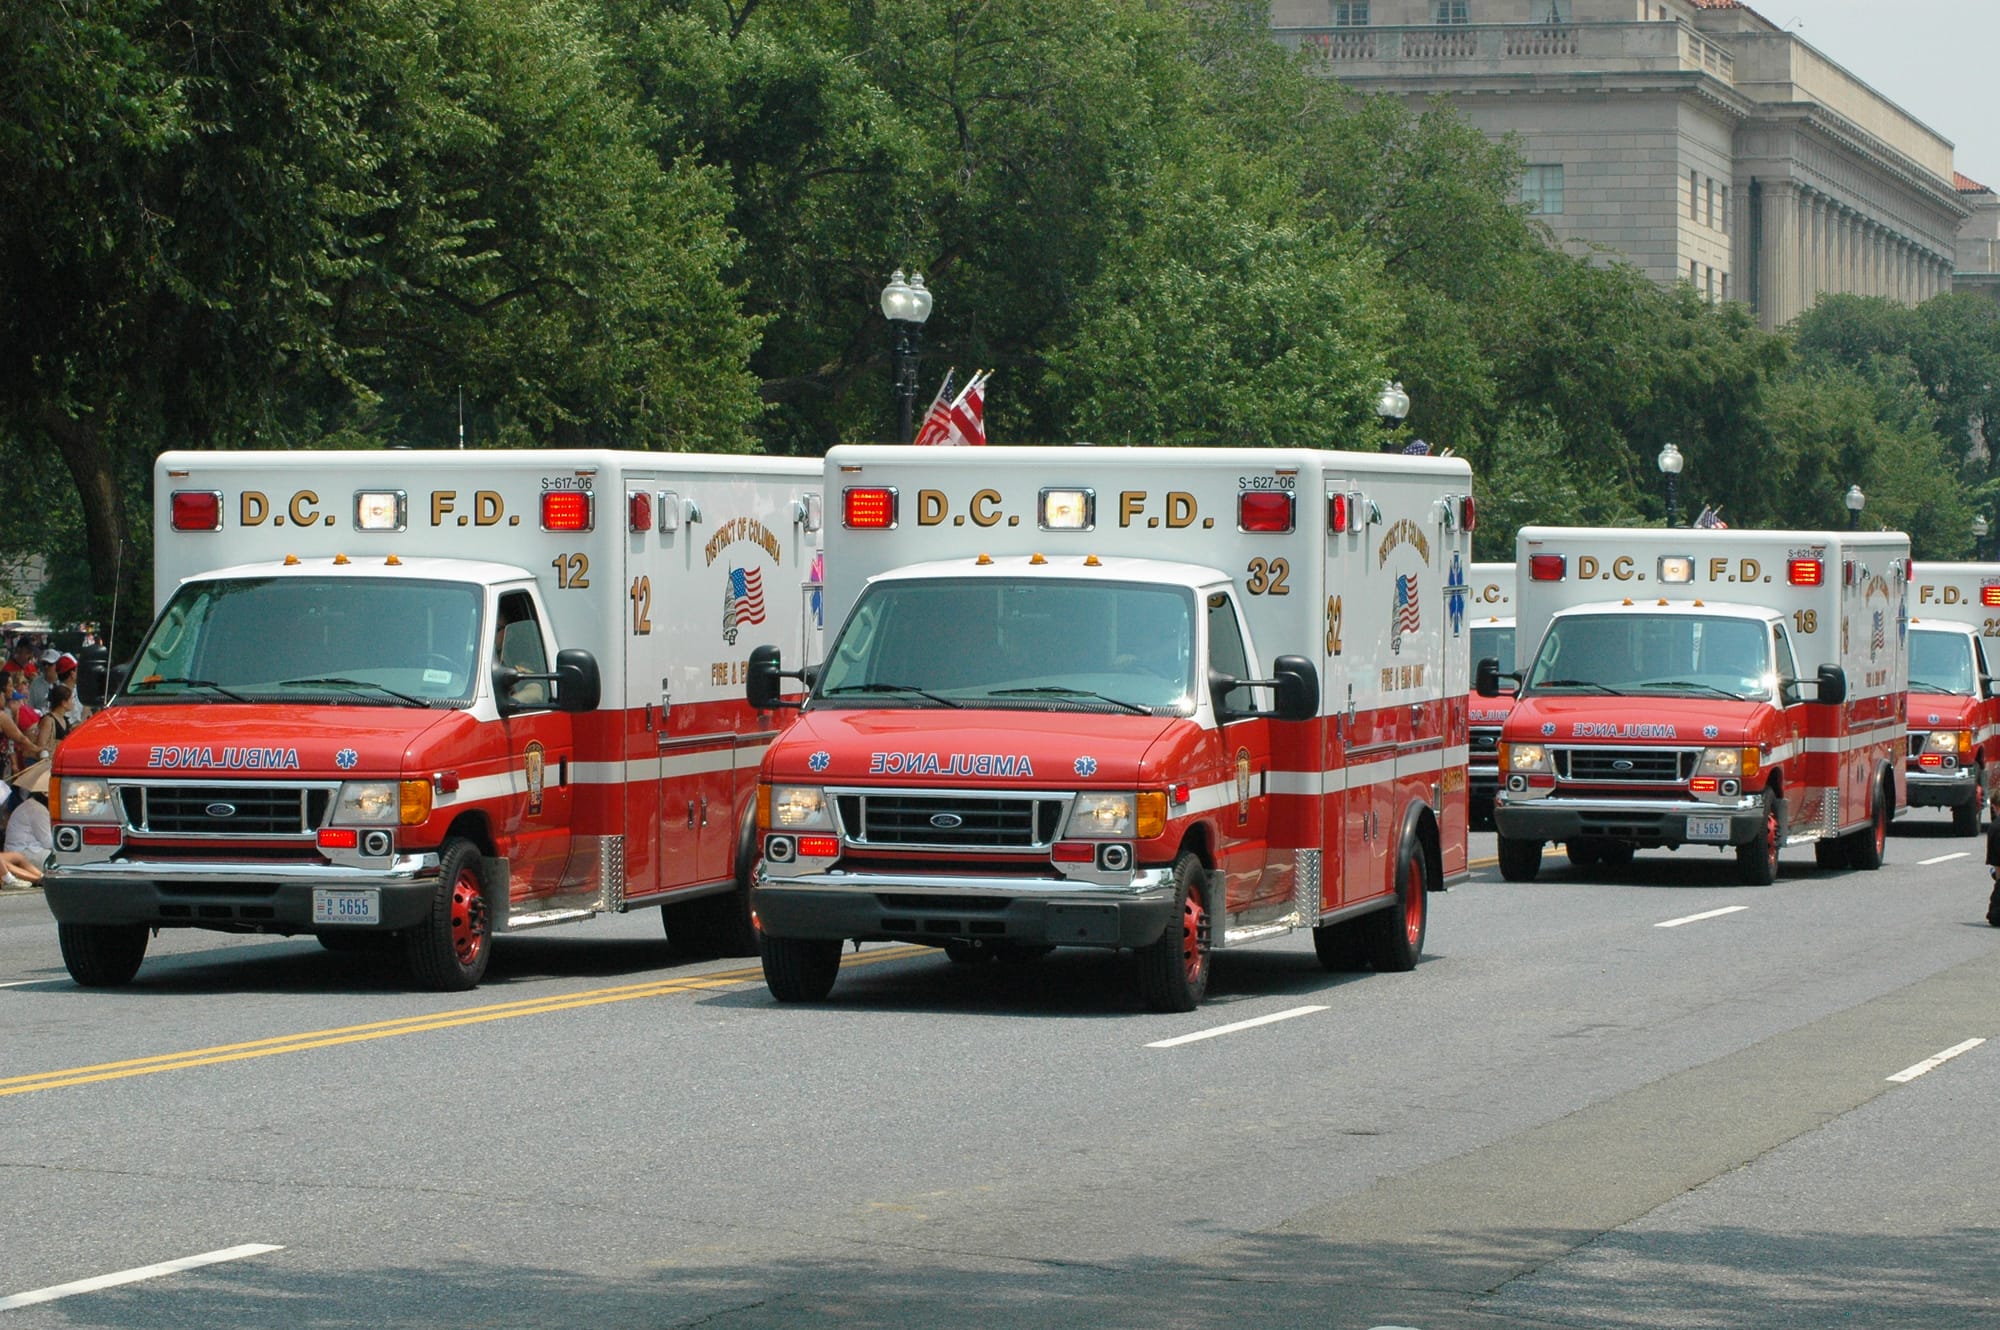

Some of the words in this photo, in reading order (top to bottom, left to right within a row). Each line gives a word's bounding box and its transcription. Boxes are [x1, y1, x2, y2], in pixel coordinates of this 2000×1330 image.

[541, 477, 592, 489] S-617-06
[1238, 476, 1296, 489] S-627-06
[240, 489, 336, 527] D.C.
[430, 490, 520, 527] F.D.
[917, 488, 1020, 527] D.C.
[1118, 490, 1215, 529] F.D.
[705, 519, 736, 567] DISTRICT
[738, 516, 747, 541] OF
[749, 518, 781, 567] COLUMBIA
[552, 552, 590, 590] 12
[1246, 556, 1290, 596] 32
[1578, 555, 1646, 581] D.C.
[1709, 557, 1772, 583] F.D.
[630, 575, 651, 636] 12
[1470, 584, 1509, 603] .C.
[1920, 585, 1968, 604] F.D.
[1327, 594, 1342, 657] 32
[1793, 609, 1817, 634] 18
[1704, 823, 1724, 834] 5657
[339, 899, 368, 915] 5655
